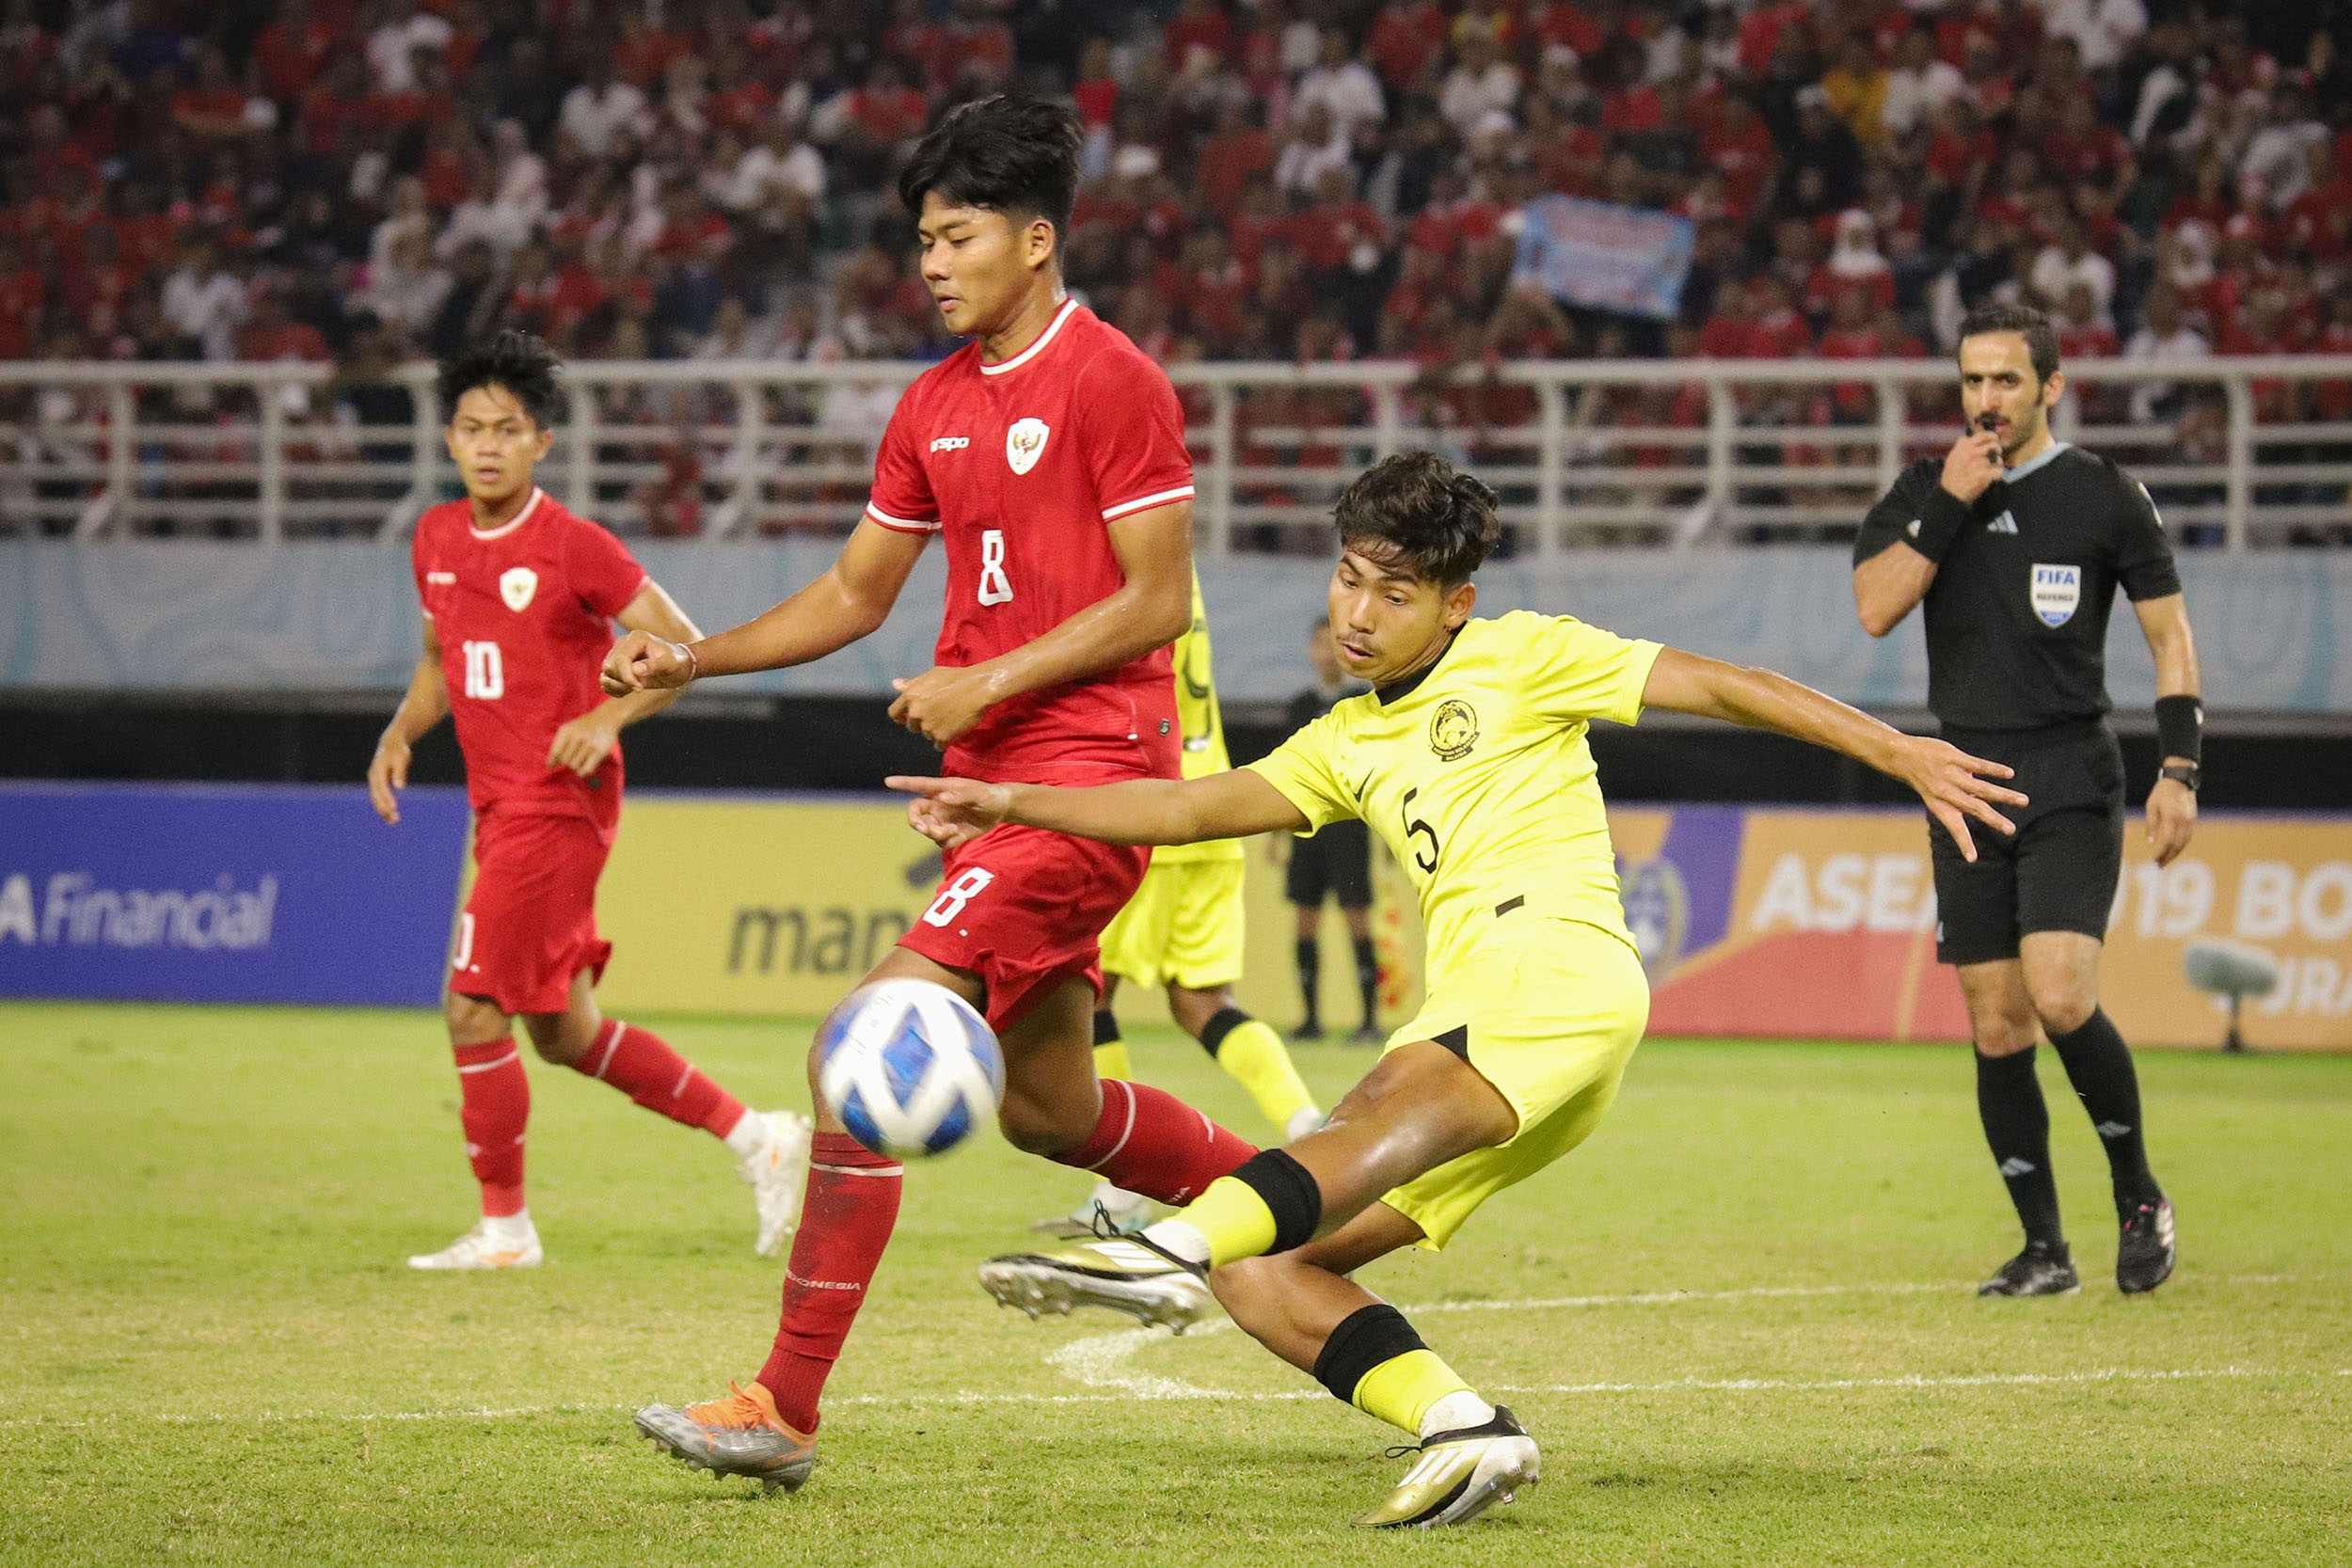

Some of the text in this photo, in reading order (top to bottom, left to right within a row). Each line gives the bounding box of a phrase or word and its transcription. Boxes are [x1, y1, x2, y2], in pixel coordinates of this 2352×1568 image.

[977, 530, 1014, 607] 8
[2037, 569, 2075, 584] FIFA
[462, 640, 505, 700] 10
[1402, 786, 1439, 875] 5
[43, 872, 278, 948] Financial
[922, 866, 995, 927] 8
